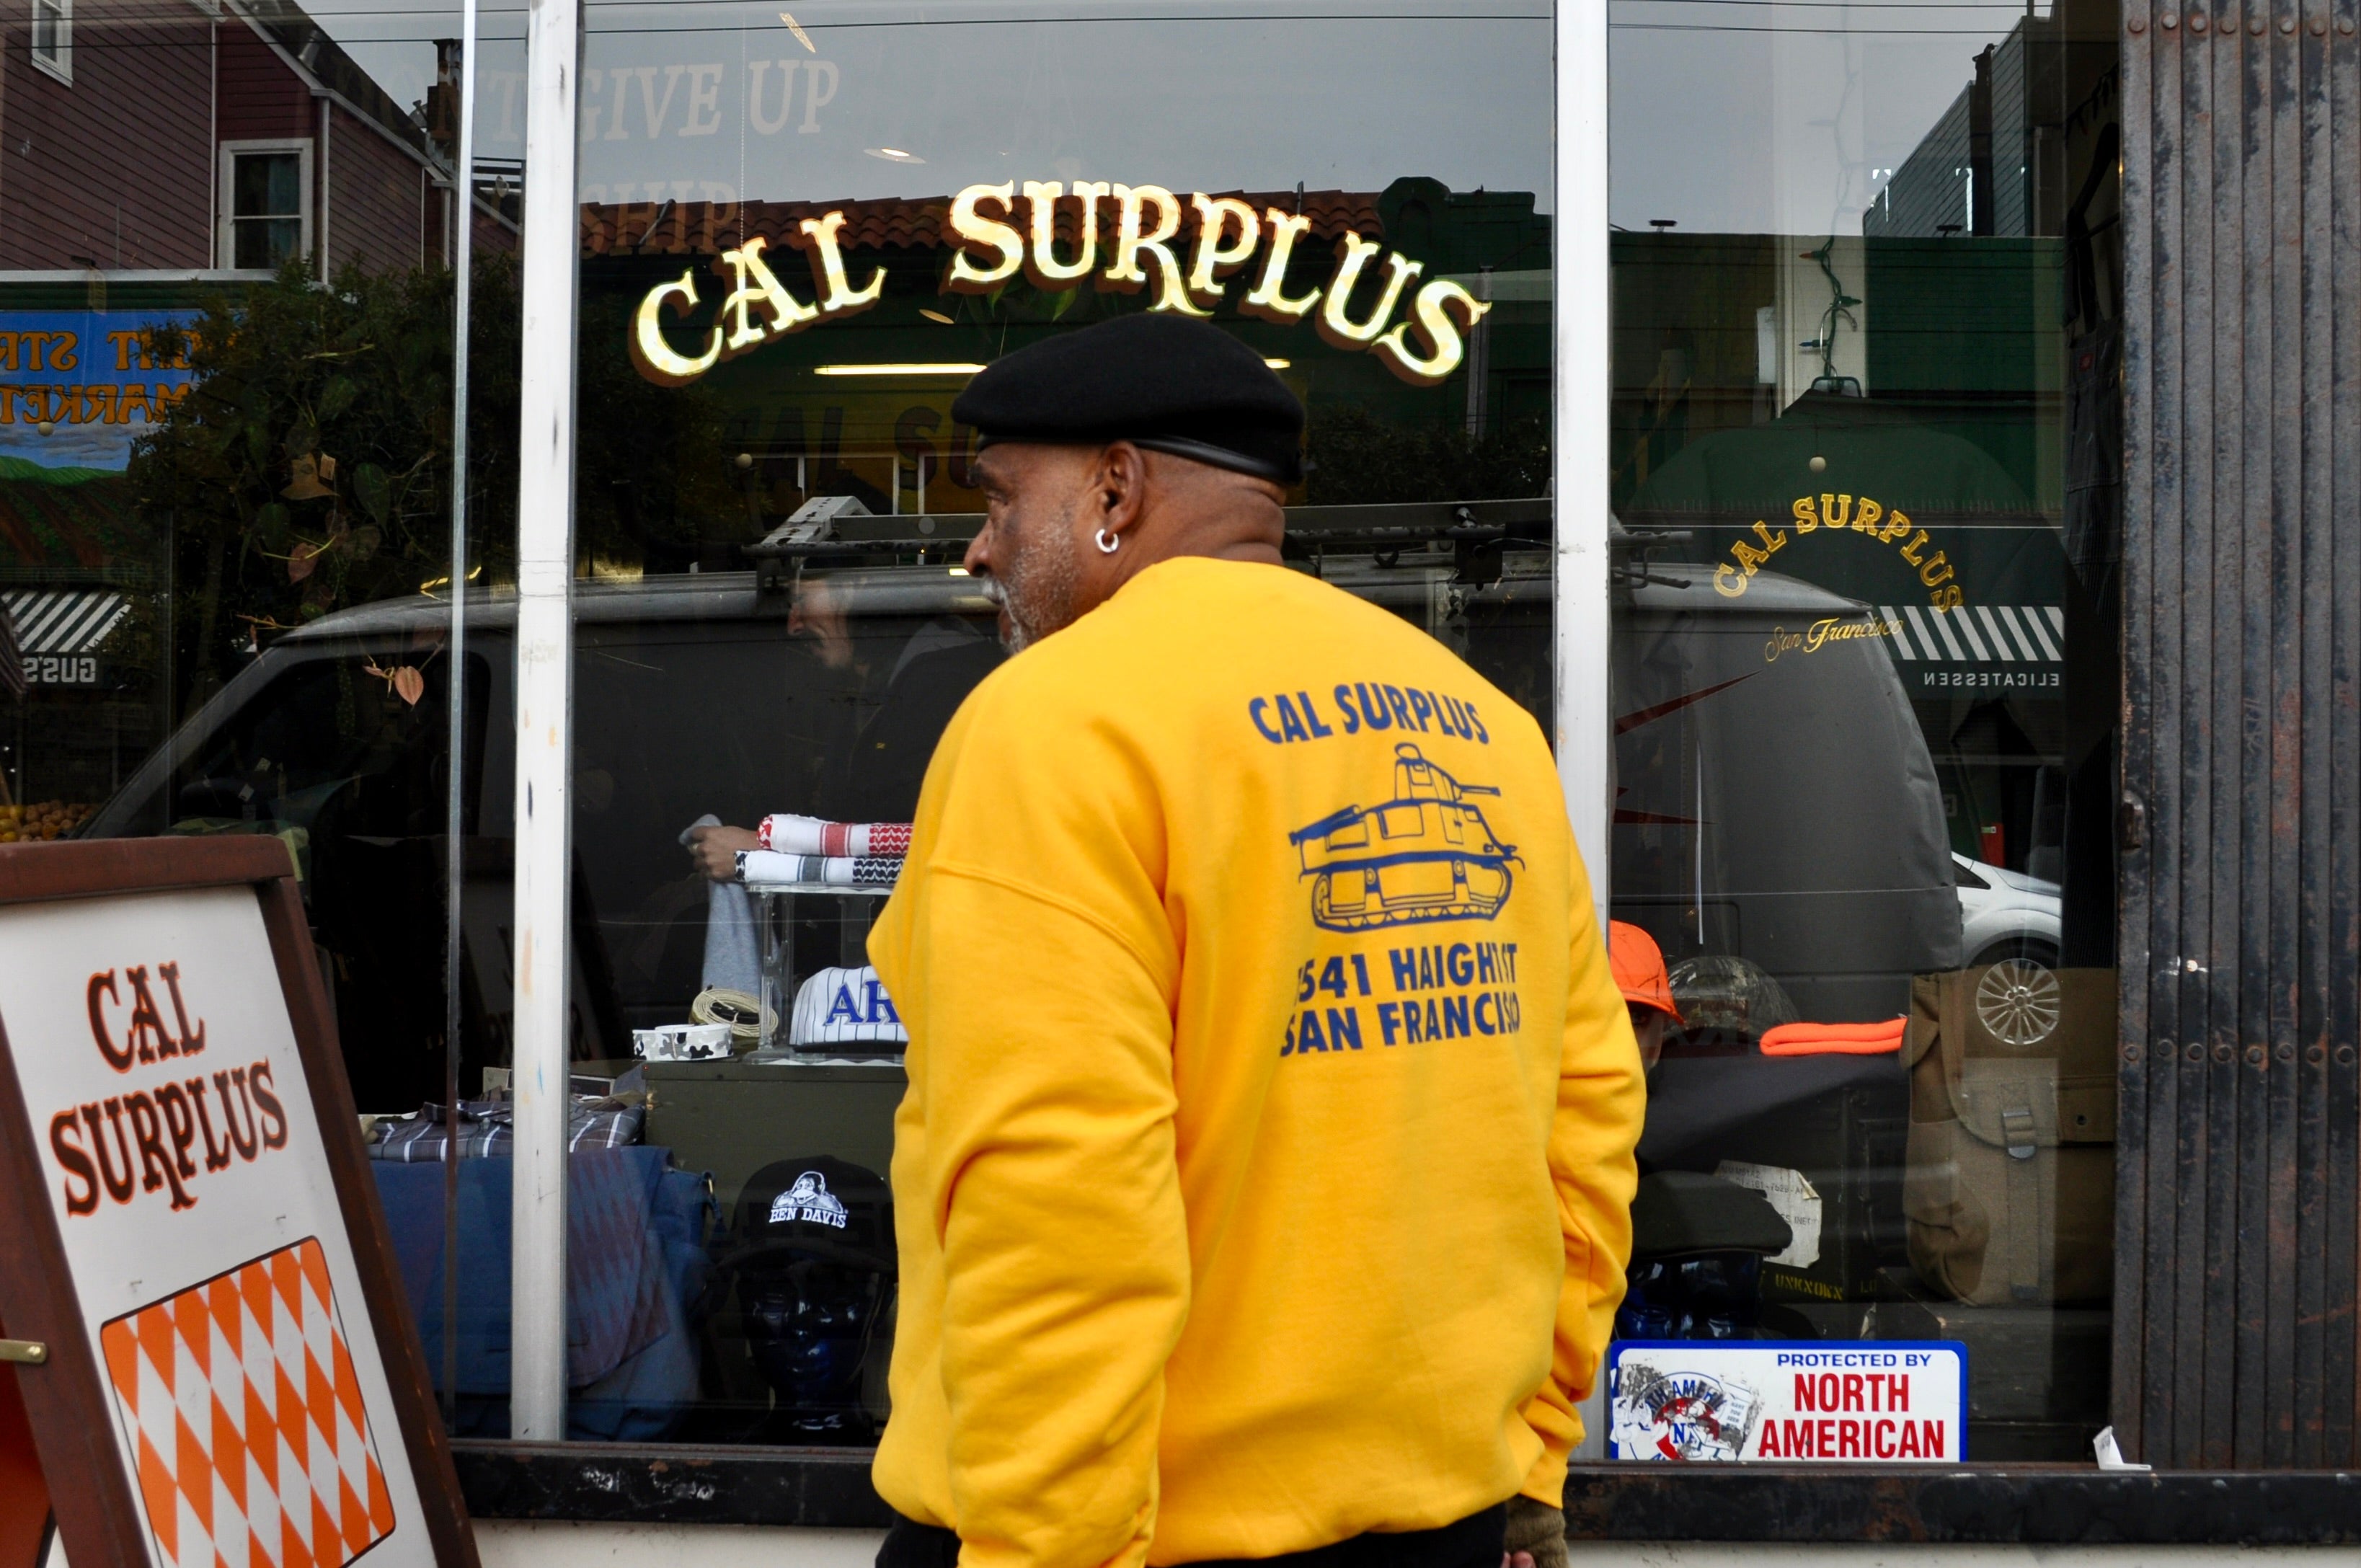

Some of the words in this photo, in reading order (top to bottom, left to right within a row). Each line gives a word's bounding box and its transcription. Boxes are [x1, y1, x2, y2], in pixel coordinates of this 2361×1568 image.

[749, 59, 840, 136] UP
[580, 180, 738, 260] SHIP
[634, 211, 887, 379] CAL
[949, 179, 1492, 380] SURPLUS
[1712, 520, 1787, 598] CAL
[1792, 493, 1964, 614] SURPLUS
[1765, 626, 1802, 663] San
[1802, 616, 1904, 653] Francisco
[1249, 690, 1334, 745] CAL
[1333, 681, 1490, 745] SURPLUS
[1294, 953, 1372, 1007] 541
[85, 960, 205, 1073] CAL
[1280, 1006, 1363, 1058] SAN
[50, 1057, 289, 1218] SURPLUS
[768, 1208, 798, 1223] BEN
[801, 1208, 847, 1228] DAVIS
[1777, 1353, 1897, 1367] PROTECTED
[1905, 1354, 1932, 1367] BY
[1794, 1373, 1910, 1413] NORTH
[1758, 1419, 1944, 1459] AMERICAN
